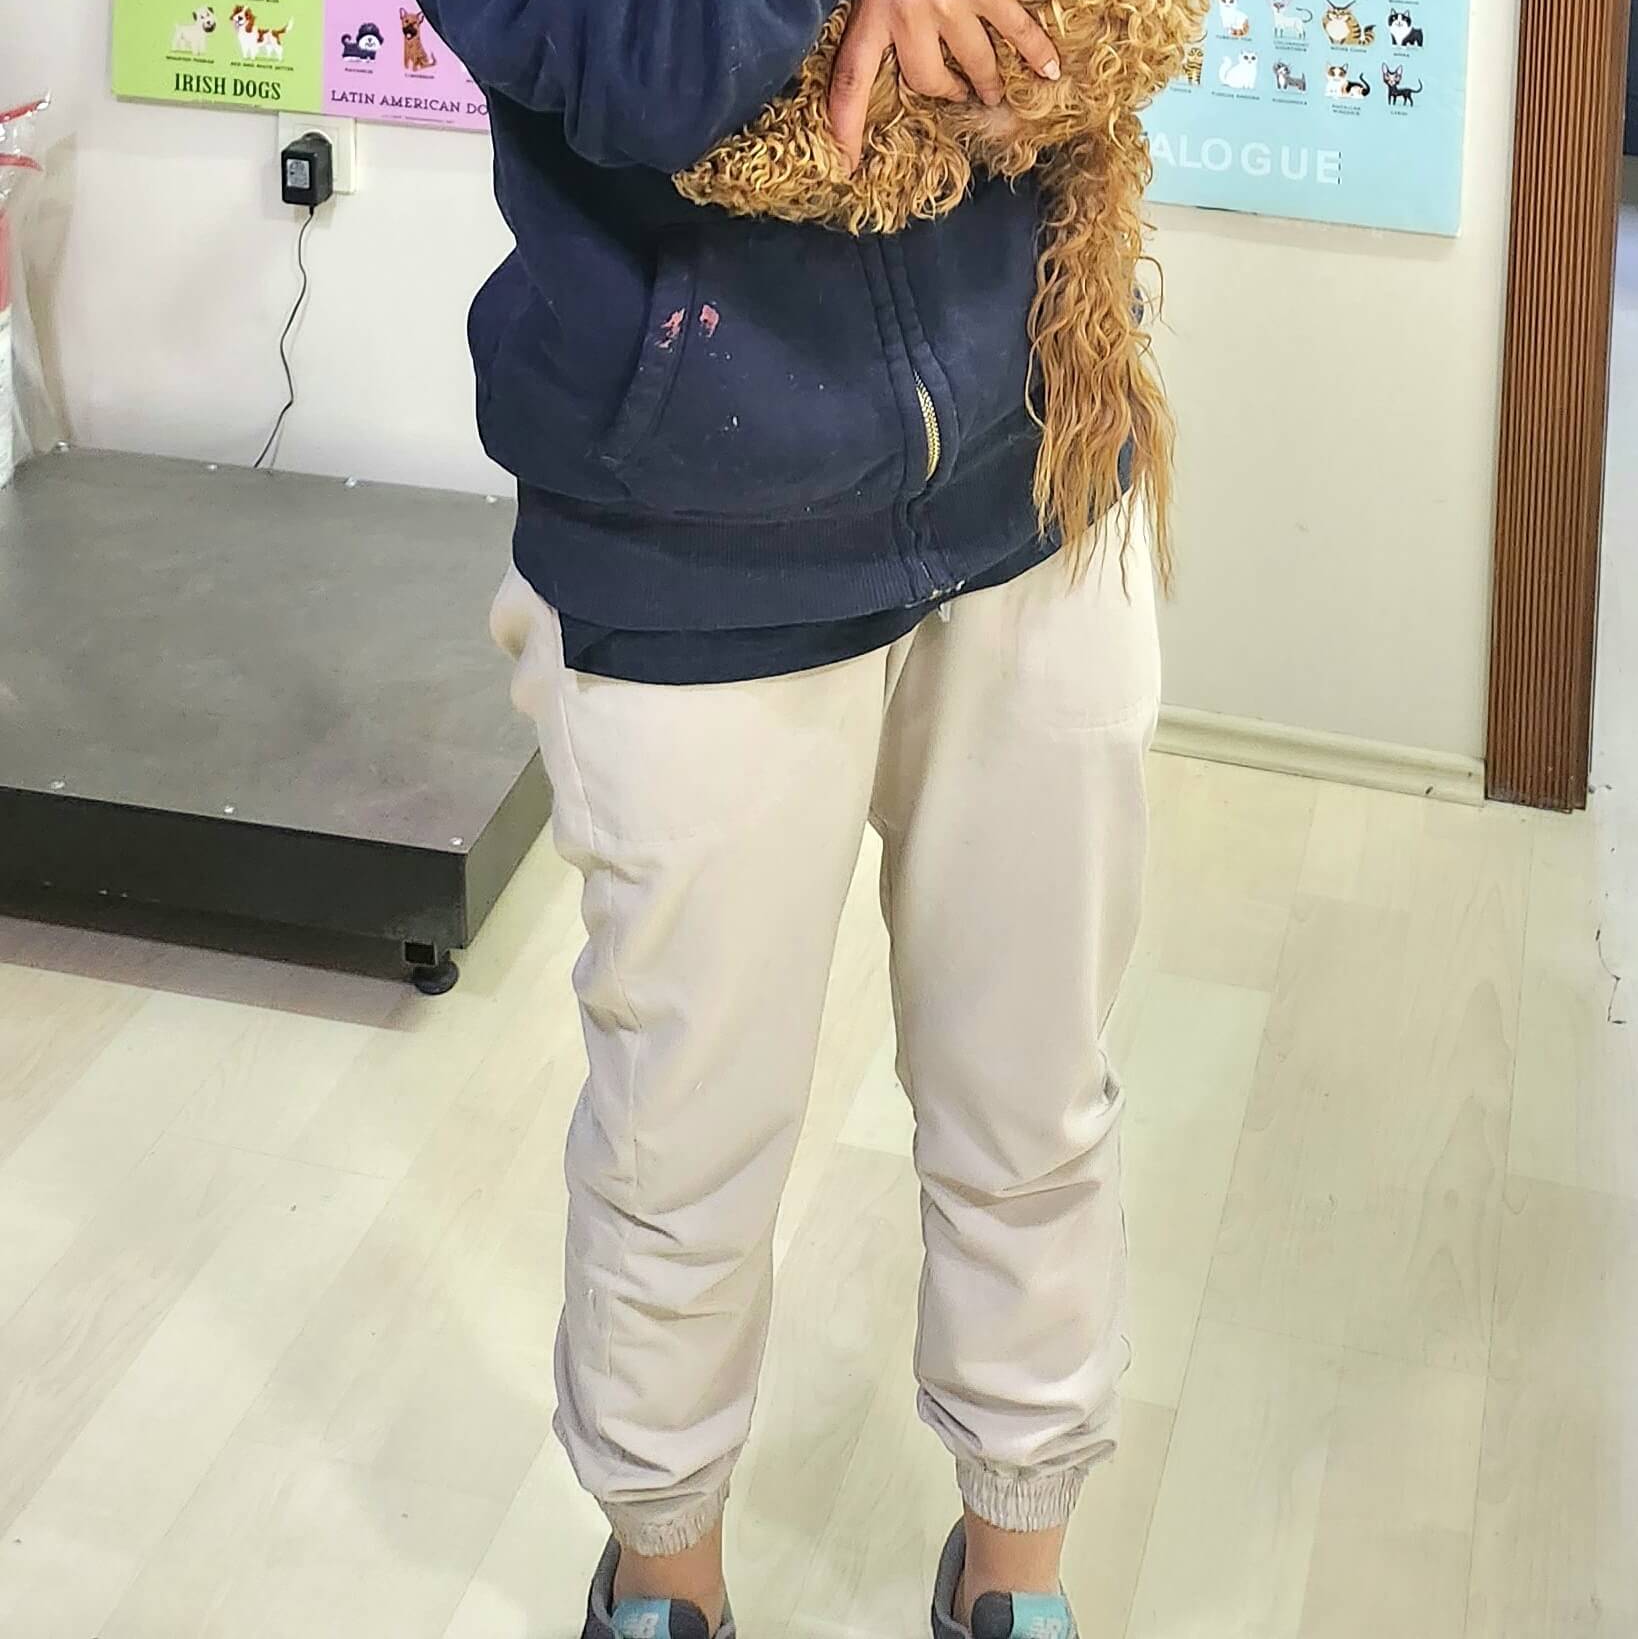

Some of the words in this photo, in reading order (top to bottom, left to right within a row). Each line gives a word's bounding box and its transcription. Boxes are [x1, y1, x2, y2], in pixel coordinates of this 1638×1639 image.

[175, 73, 225, 95] IRISH
[233, 79, 281, 100] DOGS
[331, 90, 375, 104] LATIN
[380, 96, 460, 112] AMERICAN
